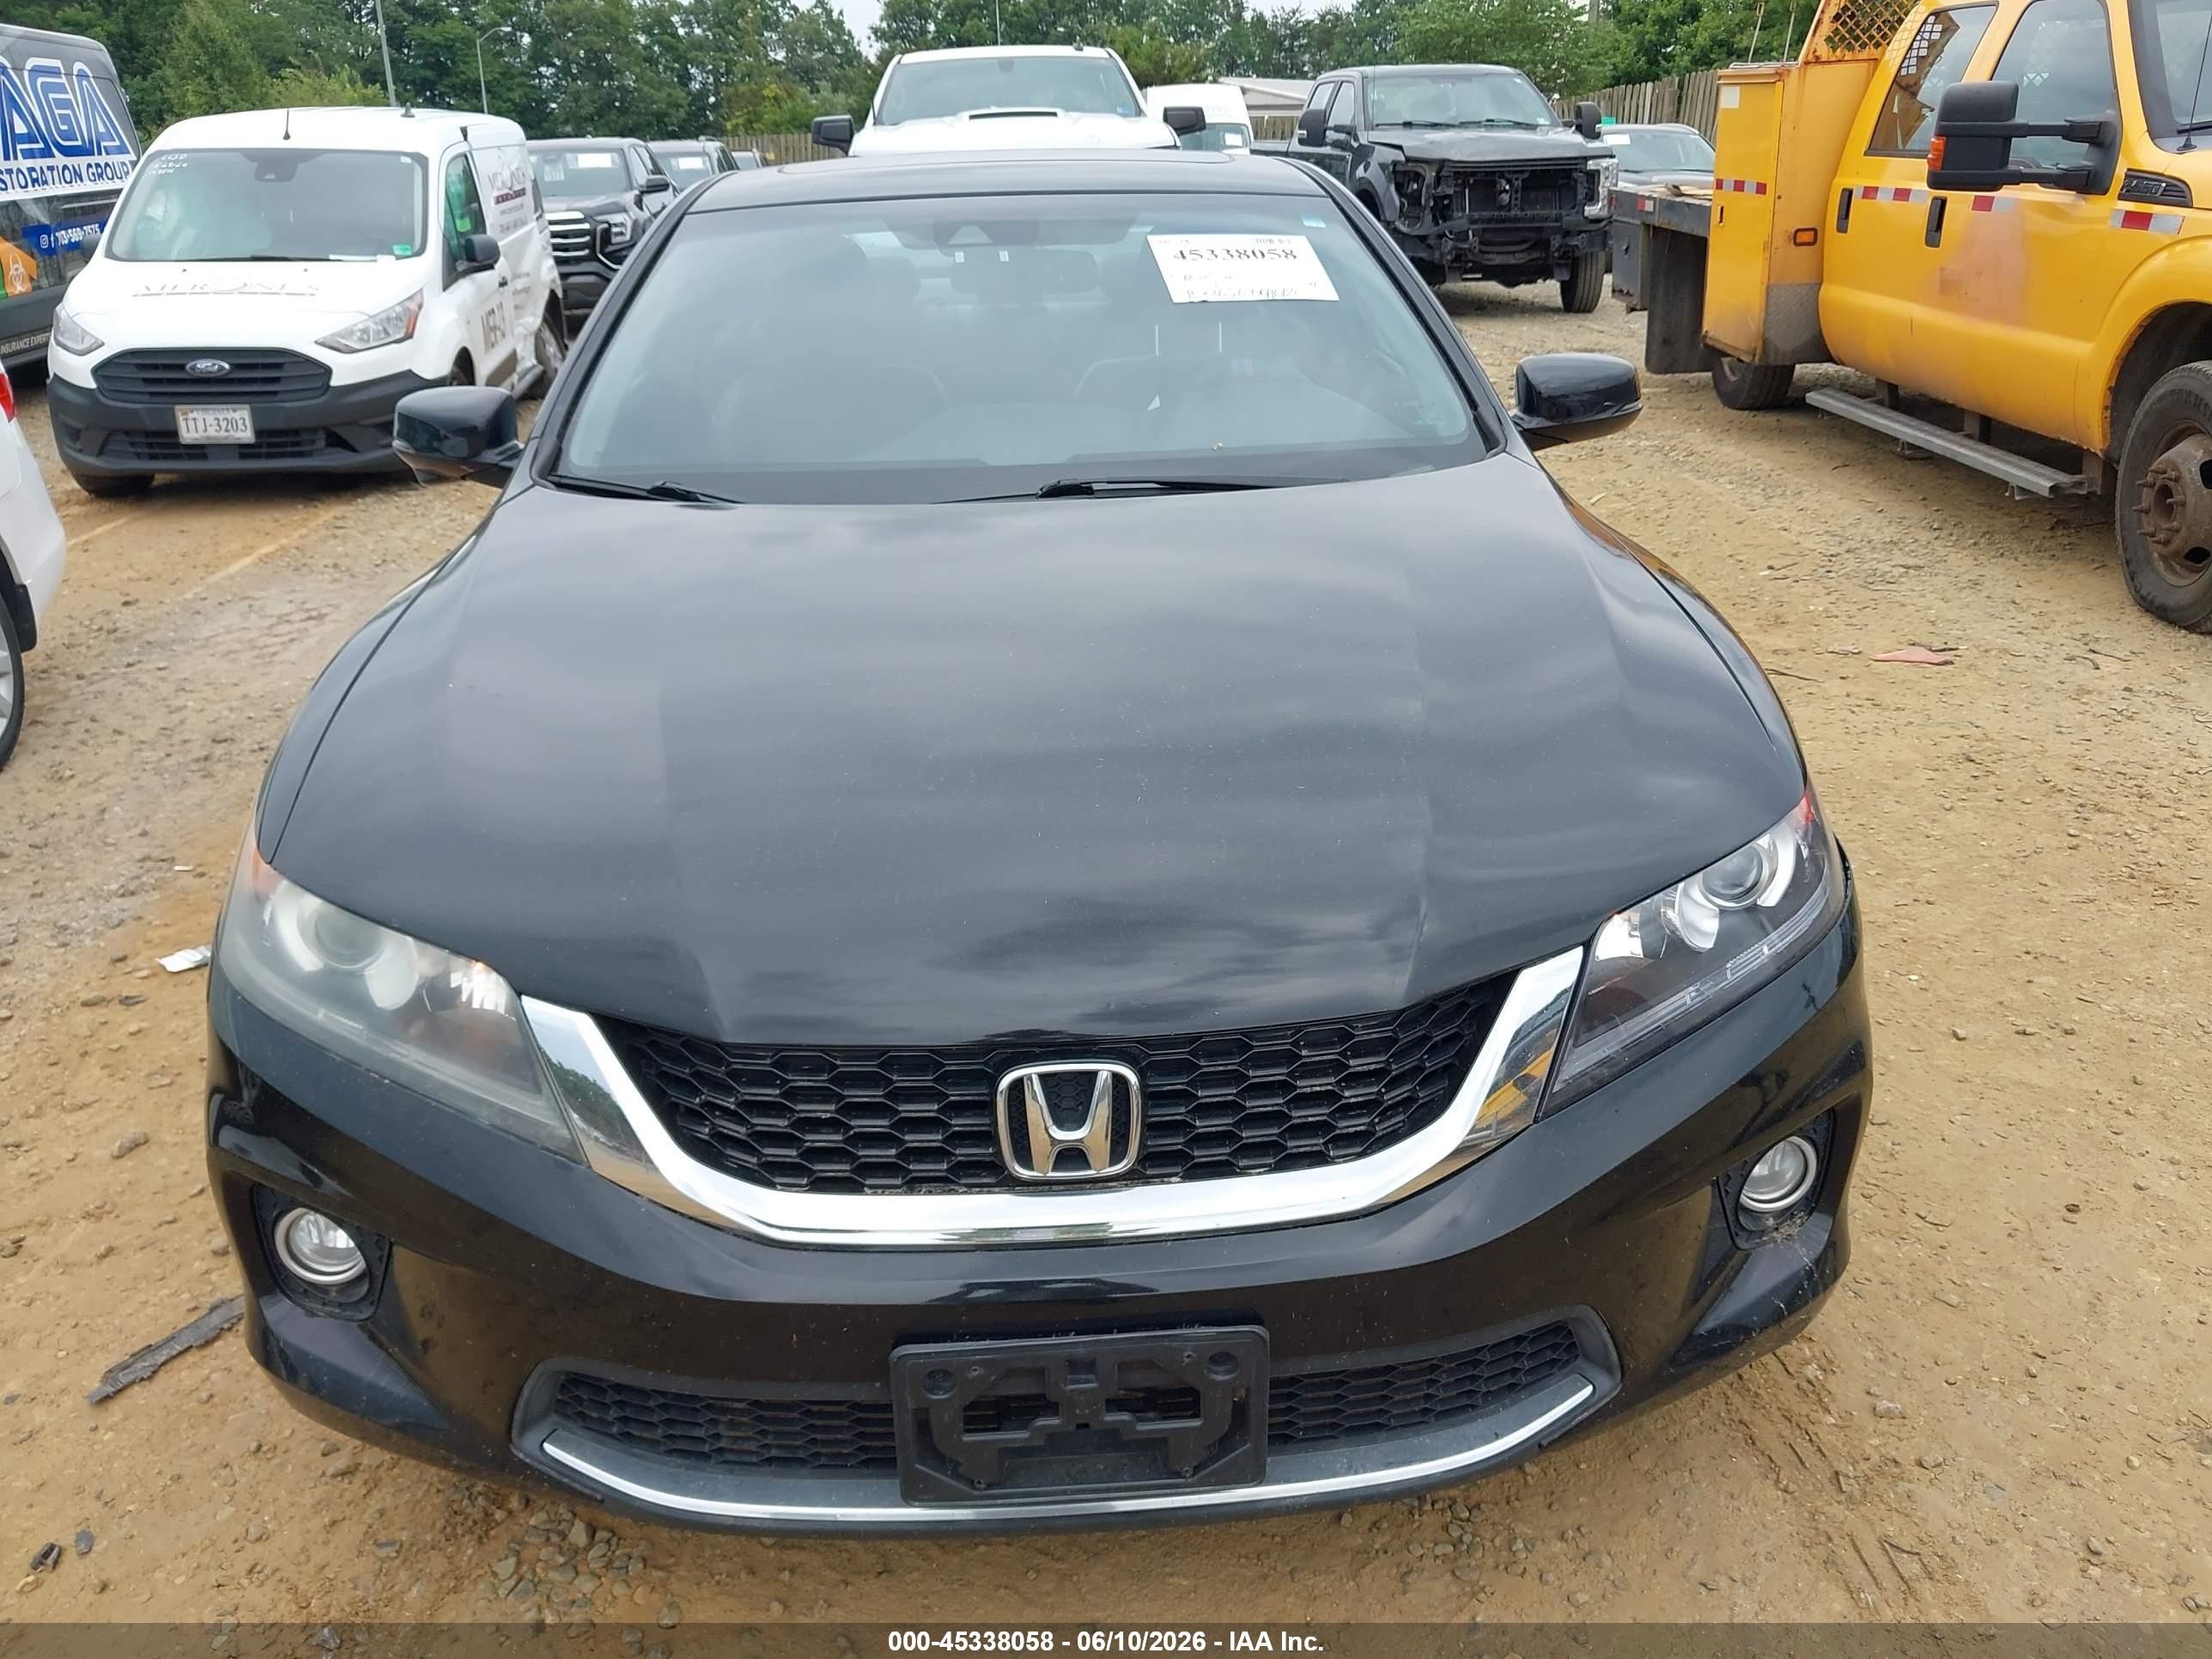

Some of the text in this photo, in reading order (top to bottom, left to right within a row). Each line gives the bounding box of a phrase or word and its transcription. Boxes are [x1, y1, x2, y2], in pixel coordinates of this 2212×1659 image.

[85, 160, 131, 183] GROUP
[1174, 248, 1298, 261] 45338058
[182, 416, 248, 434] TTJ-3203
